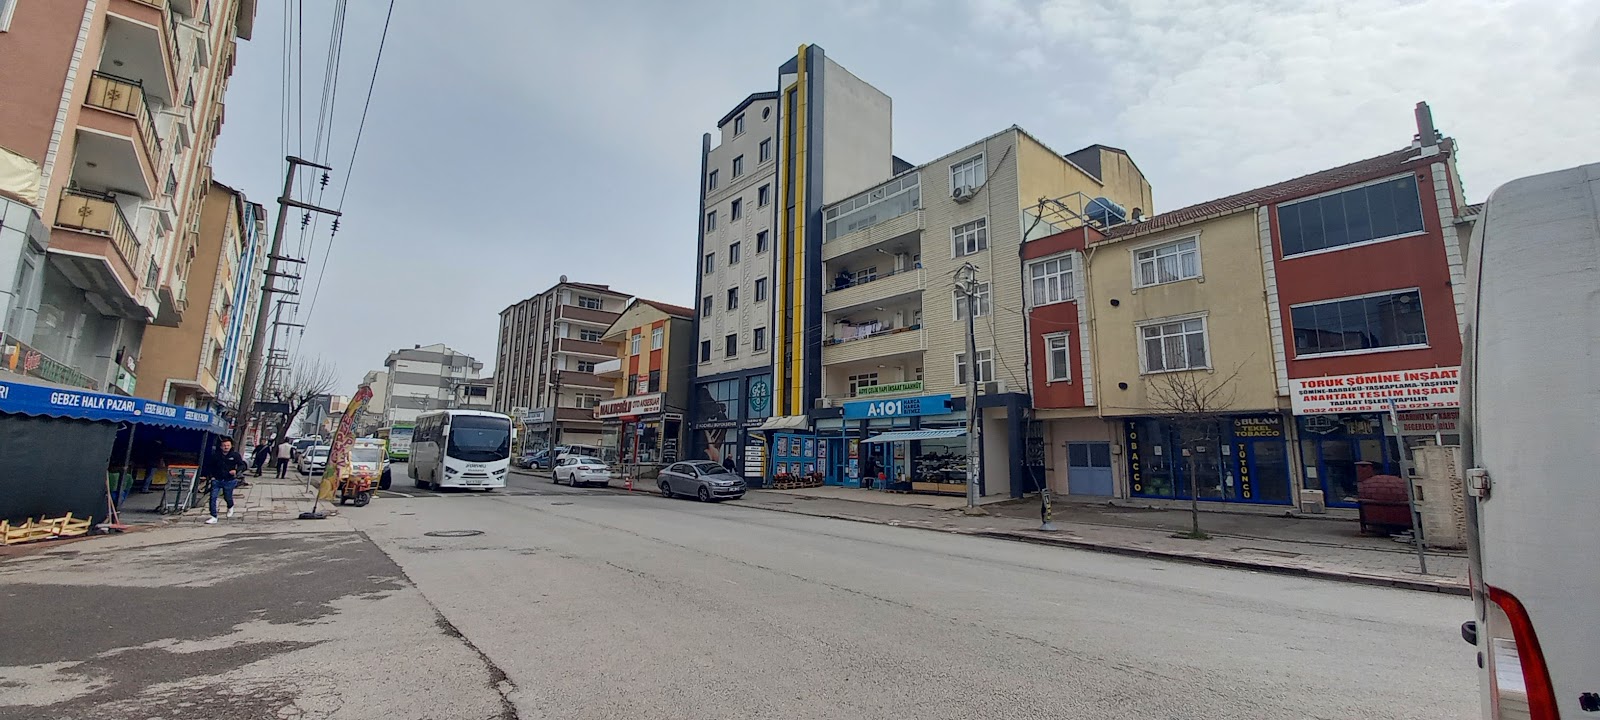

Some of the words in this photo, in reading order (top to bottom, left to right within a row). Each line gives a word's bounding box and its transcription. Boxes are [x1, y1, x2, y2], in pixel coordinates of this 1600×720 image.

[1300, 379, 1344, 388] TORUK
[1346, 374, 1401, 387] ŞÖMİNE
[1404, 370, 1459, 381] İNŞAAT
[51, 392, 79, 407] GEBZE
[82, 395, 105, 409] HALK
[106, 399, 135, 412] PAZARI
[1303, 393, 1356, 402] ANAHTAR
[1359, 388, 1403, 398] TESLİM
[1407, 387, 1456, 396] İNŞAAT
[1130, 421, 1141, 492] TOBACCO
